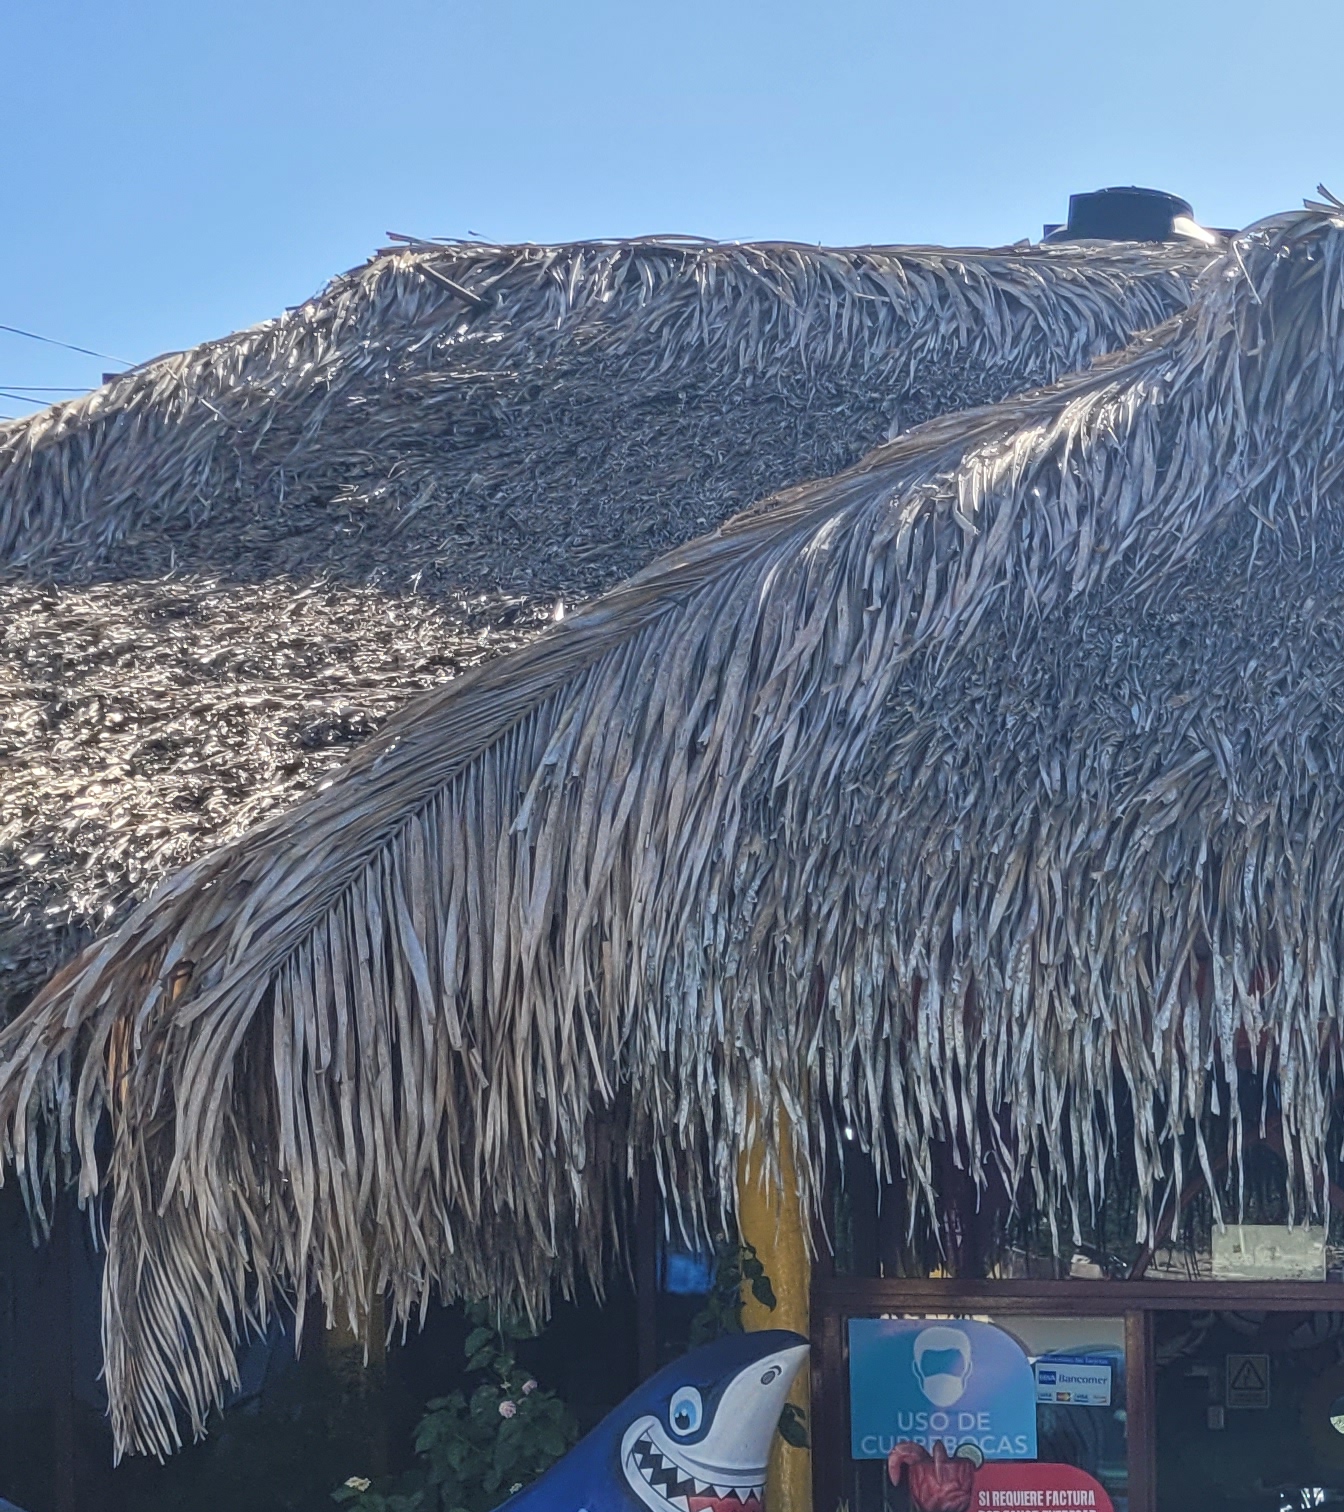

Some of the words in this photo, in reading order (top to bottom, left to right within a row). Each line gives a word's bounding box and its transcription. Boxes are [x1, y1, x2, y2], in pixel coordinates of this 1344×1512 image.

[1058, 1374, 1108, 1385] Bancomer
[897, 1411, 950, 1431] USO
[958, 1412, 991, 1431] DE
[978, 1490, 990, 1507] SI
[992, 1490, 1044, 1507] REQUIERE
[1046, 1489, 1096, 1507] FACTURA
